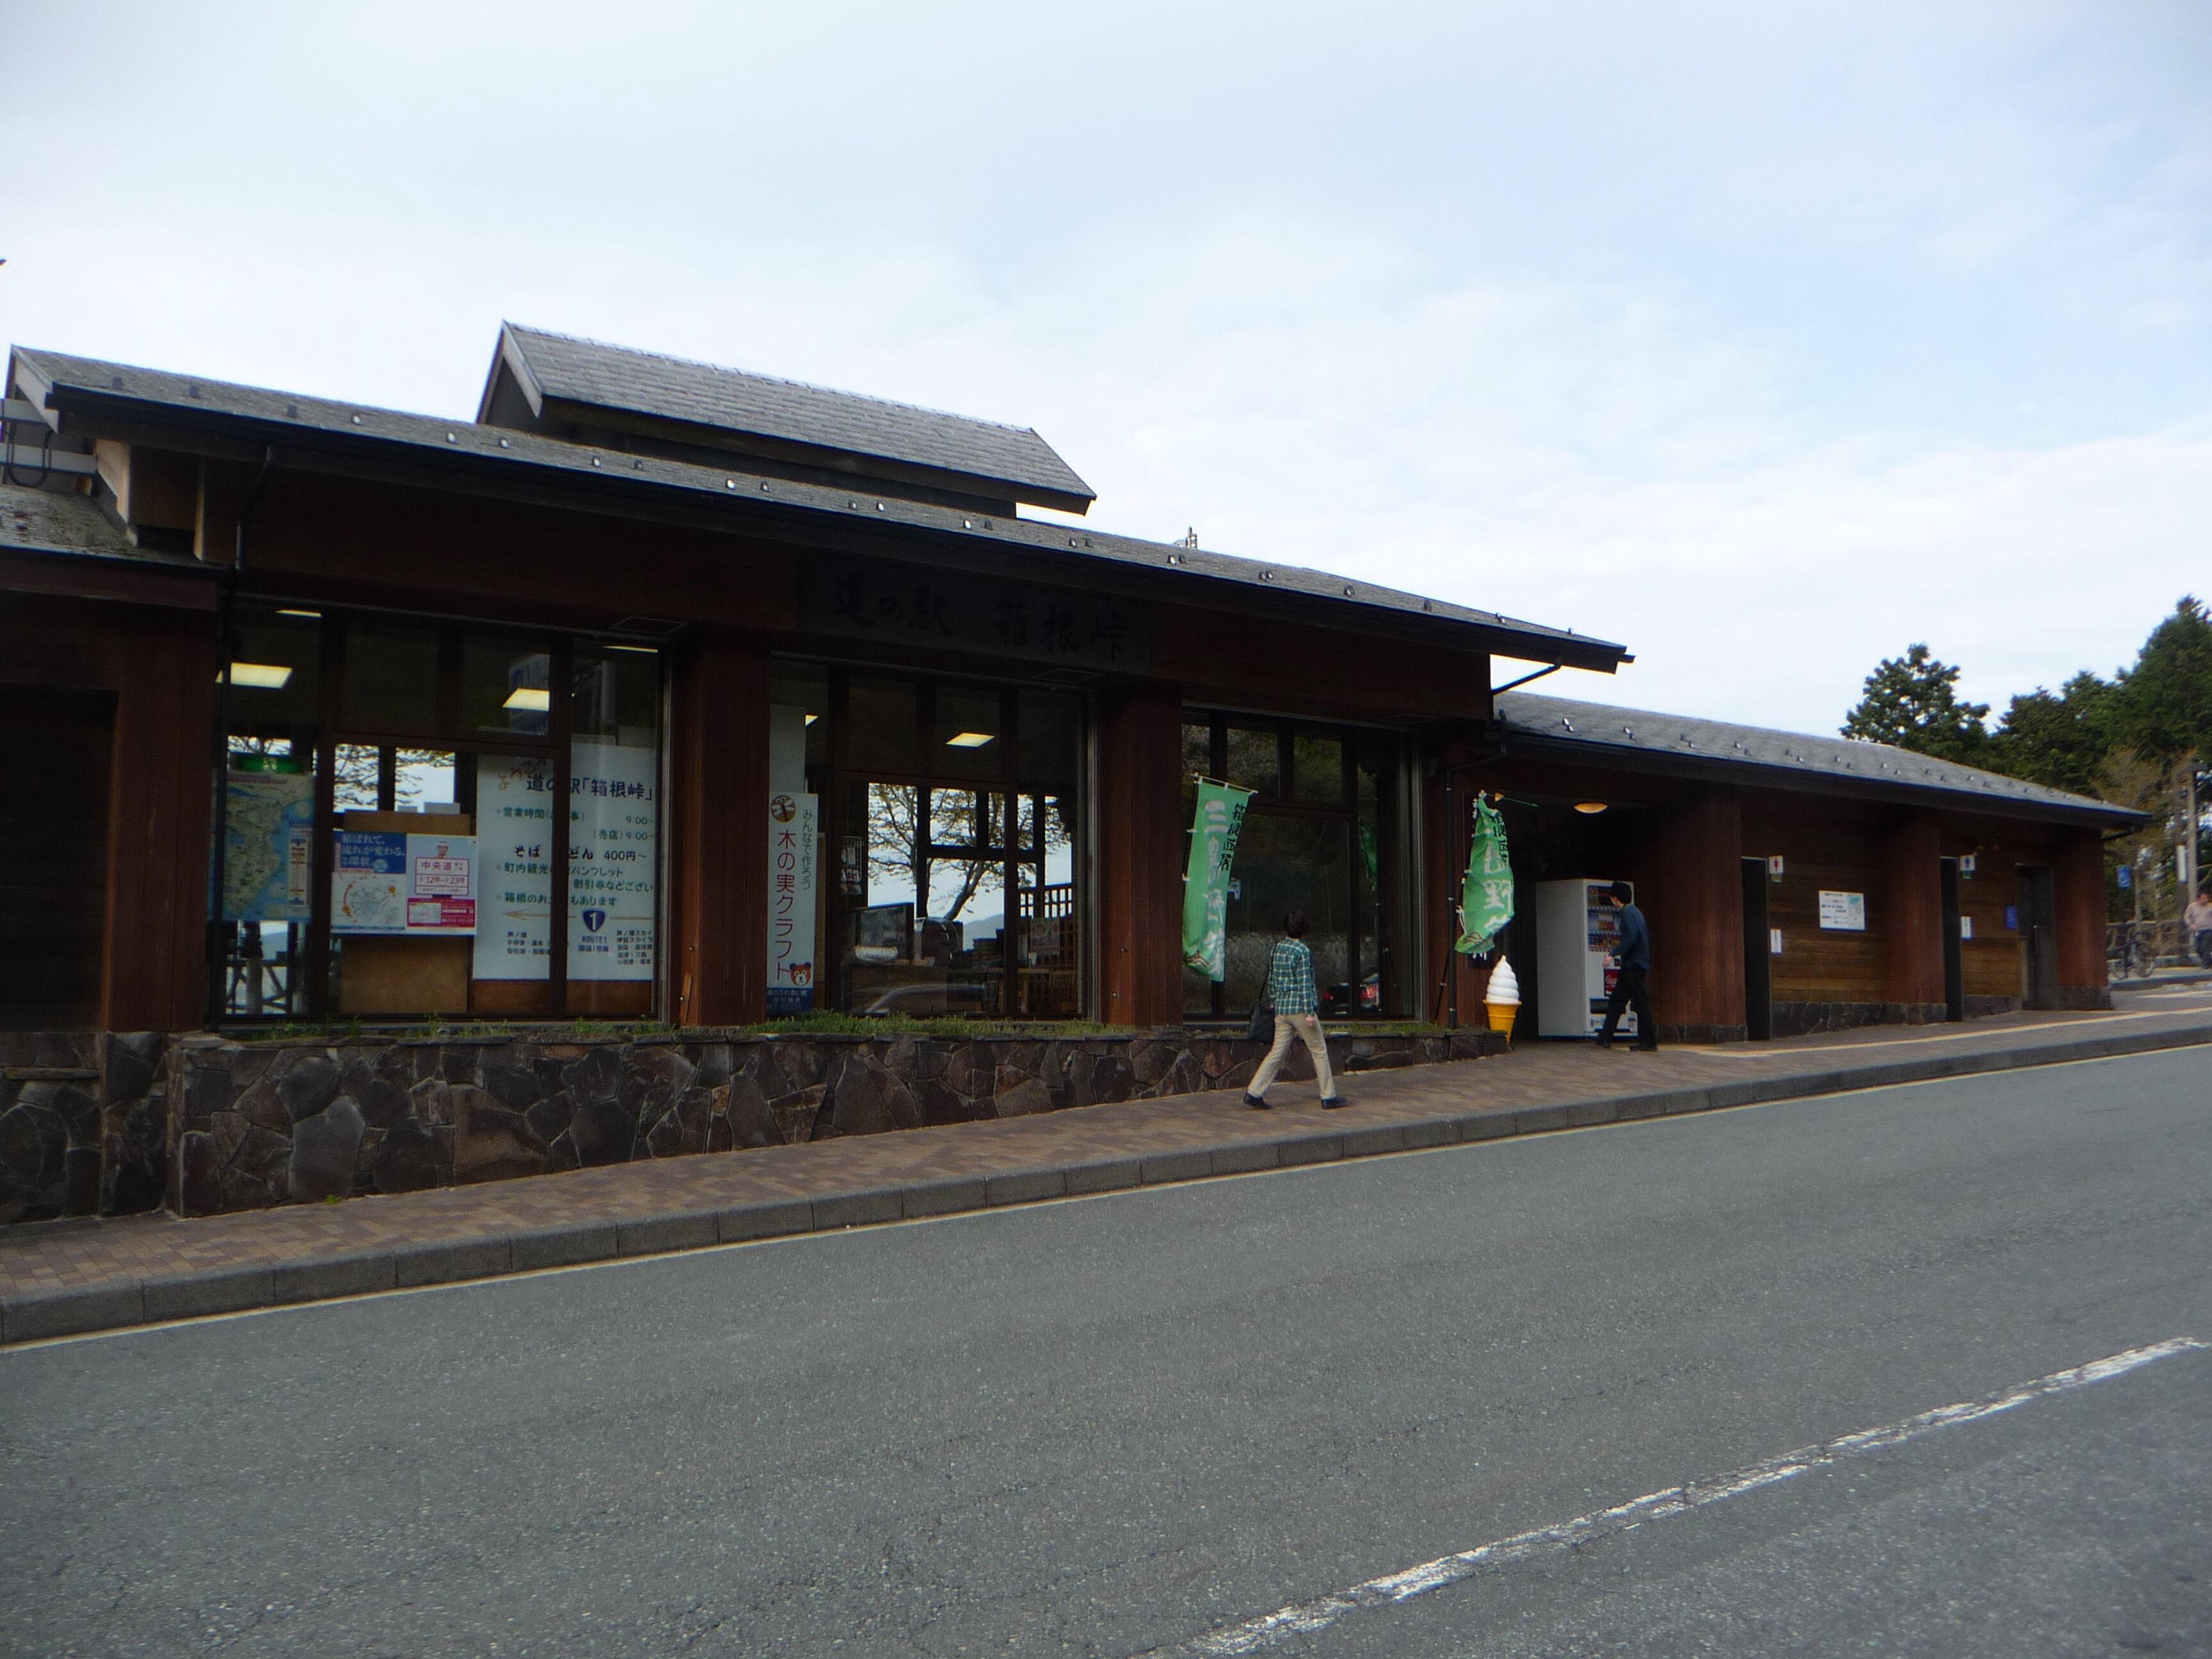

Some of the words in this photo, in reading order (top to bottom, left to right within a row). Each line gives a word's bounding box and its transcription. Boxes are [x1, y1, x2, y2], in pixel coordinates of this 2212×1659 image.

[513, 844, 541, 858] そば
[801, 809, 813, 891] みんなで作ろう
[421, 862, 452, 871] 中央道
[504, 863, 623, 877] 町内観光パンフレット
[505, 892, 617, 906] 箱根のおもあります
[776, 830, 797, 981] 木の実クラフト
[589, 912, 597, 930] 1
